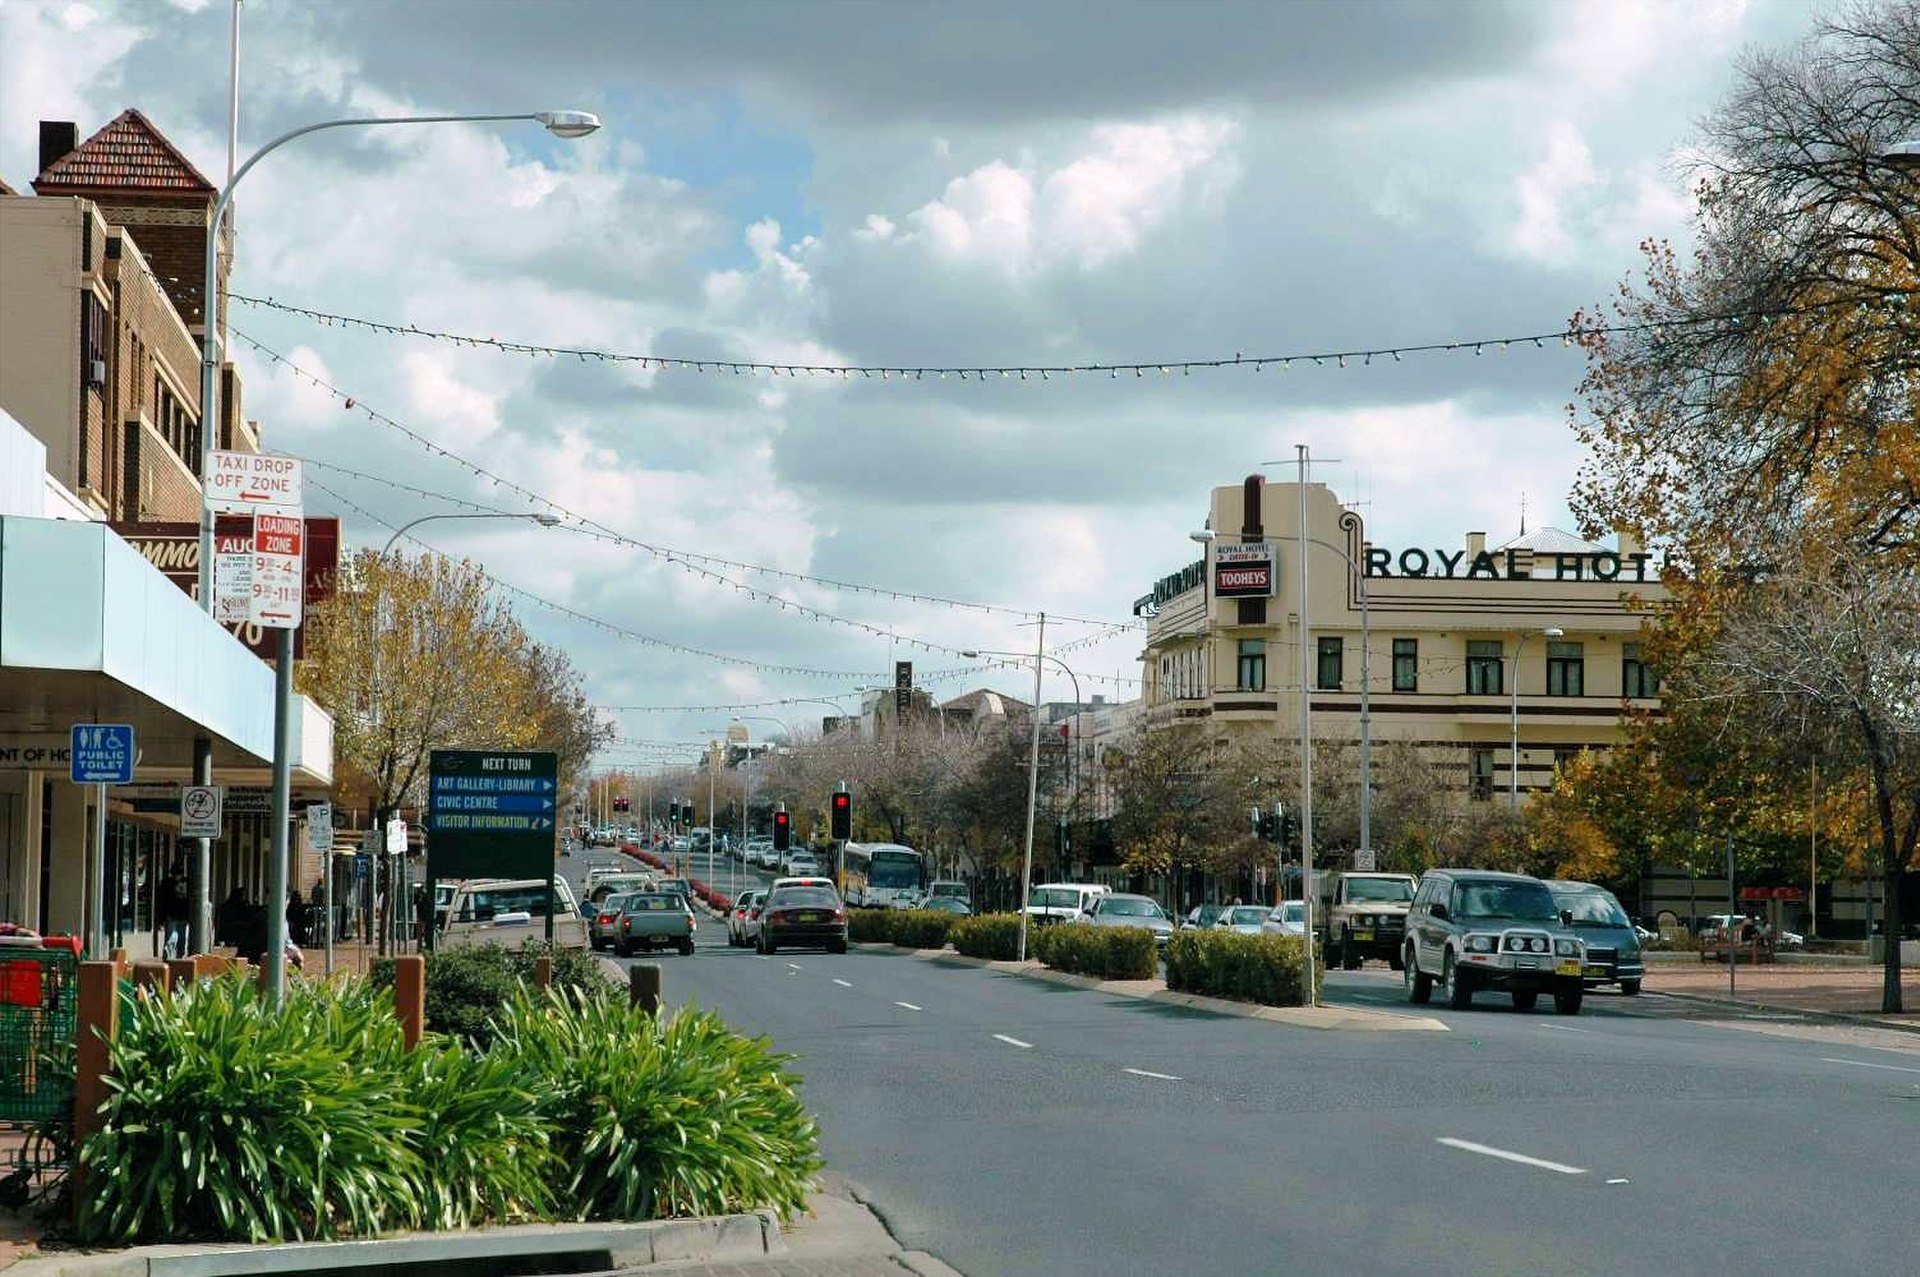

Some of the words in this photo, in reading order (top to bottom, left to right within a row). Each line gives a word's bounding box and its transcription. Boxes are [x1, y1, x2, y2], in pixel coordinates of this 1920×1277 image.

[215, 455, 248, 472] TAXI
[254, 458, 294, 475] DROP
[215, 474, 243, 488] OFF
[251, 476, 290, 492] ZONE
[257, 515, 299, 535] LOADING
[265, 535, 293, 553] ZONE
[1365, 548, 1534, 580] ROYAL
[1220, 571, 1267, 587] TOOHEYS
[24, 748, 46, 762] OF
[79, 750, 124, 760] PUBLIC
[78, 760, 124, 769] TOILET
[482, 757, 505, 771] NEXT
[508, 758, 531, 771] TURN
[437, 777, 455, 790] ART
[437, 796, 461, 809] CIVIC
[464, 796, 498, 810] CENTRE
[436, 815, 470, 829] VISITOR
[472, 815, 529, 829] INFORMATION
